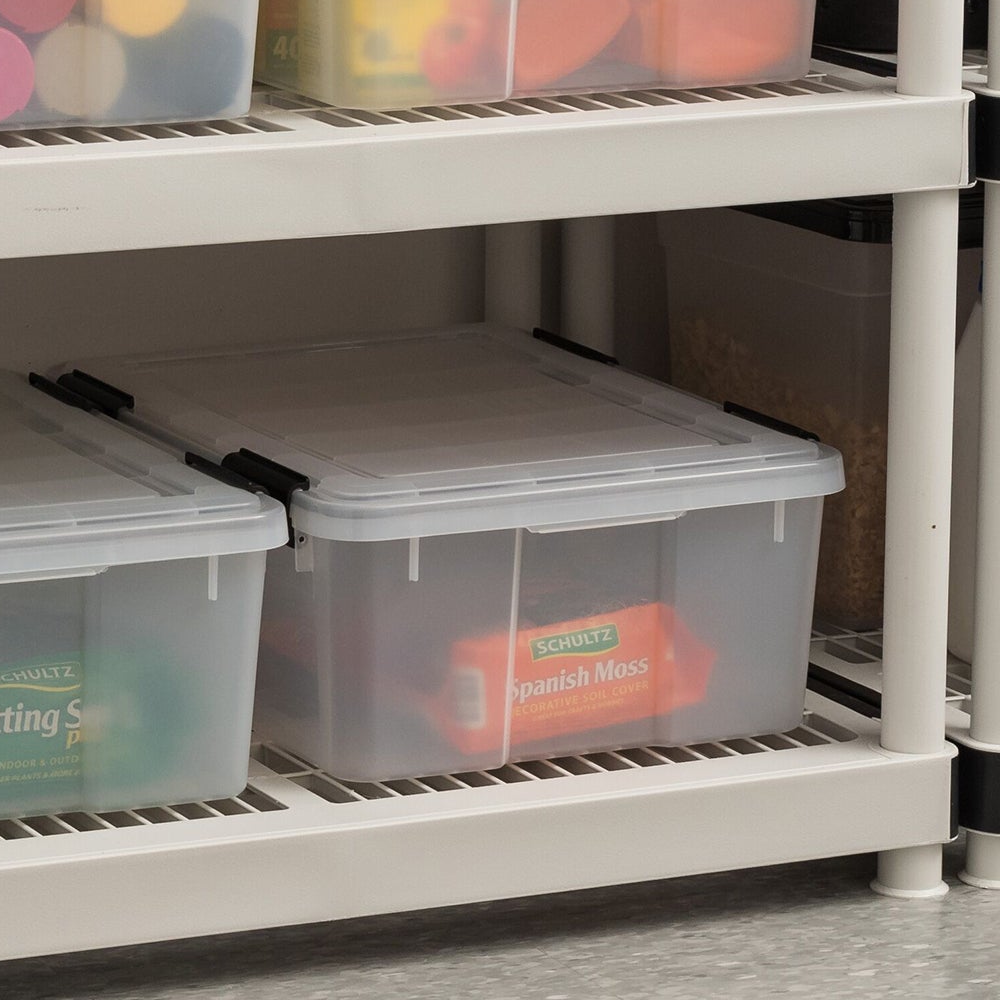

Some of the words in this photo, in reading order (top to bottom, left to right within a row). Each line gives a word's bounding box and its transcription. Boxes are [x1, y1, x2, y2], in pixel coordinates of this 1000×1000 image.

[536, 627, 613, 655] SCHULTZ
[594, 657, 649, 684] Moss
[583, 689, 607, 704] SOIL
[611, 680, 650, 699] COVER
